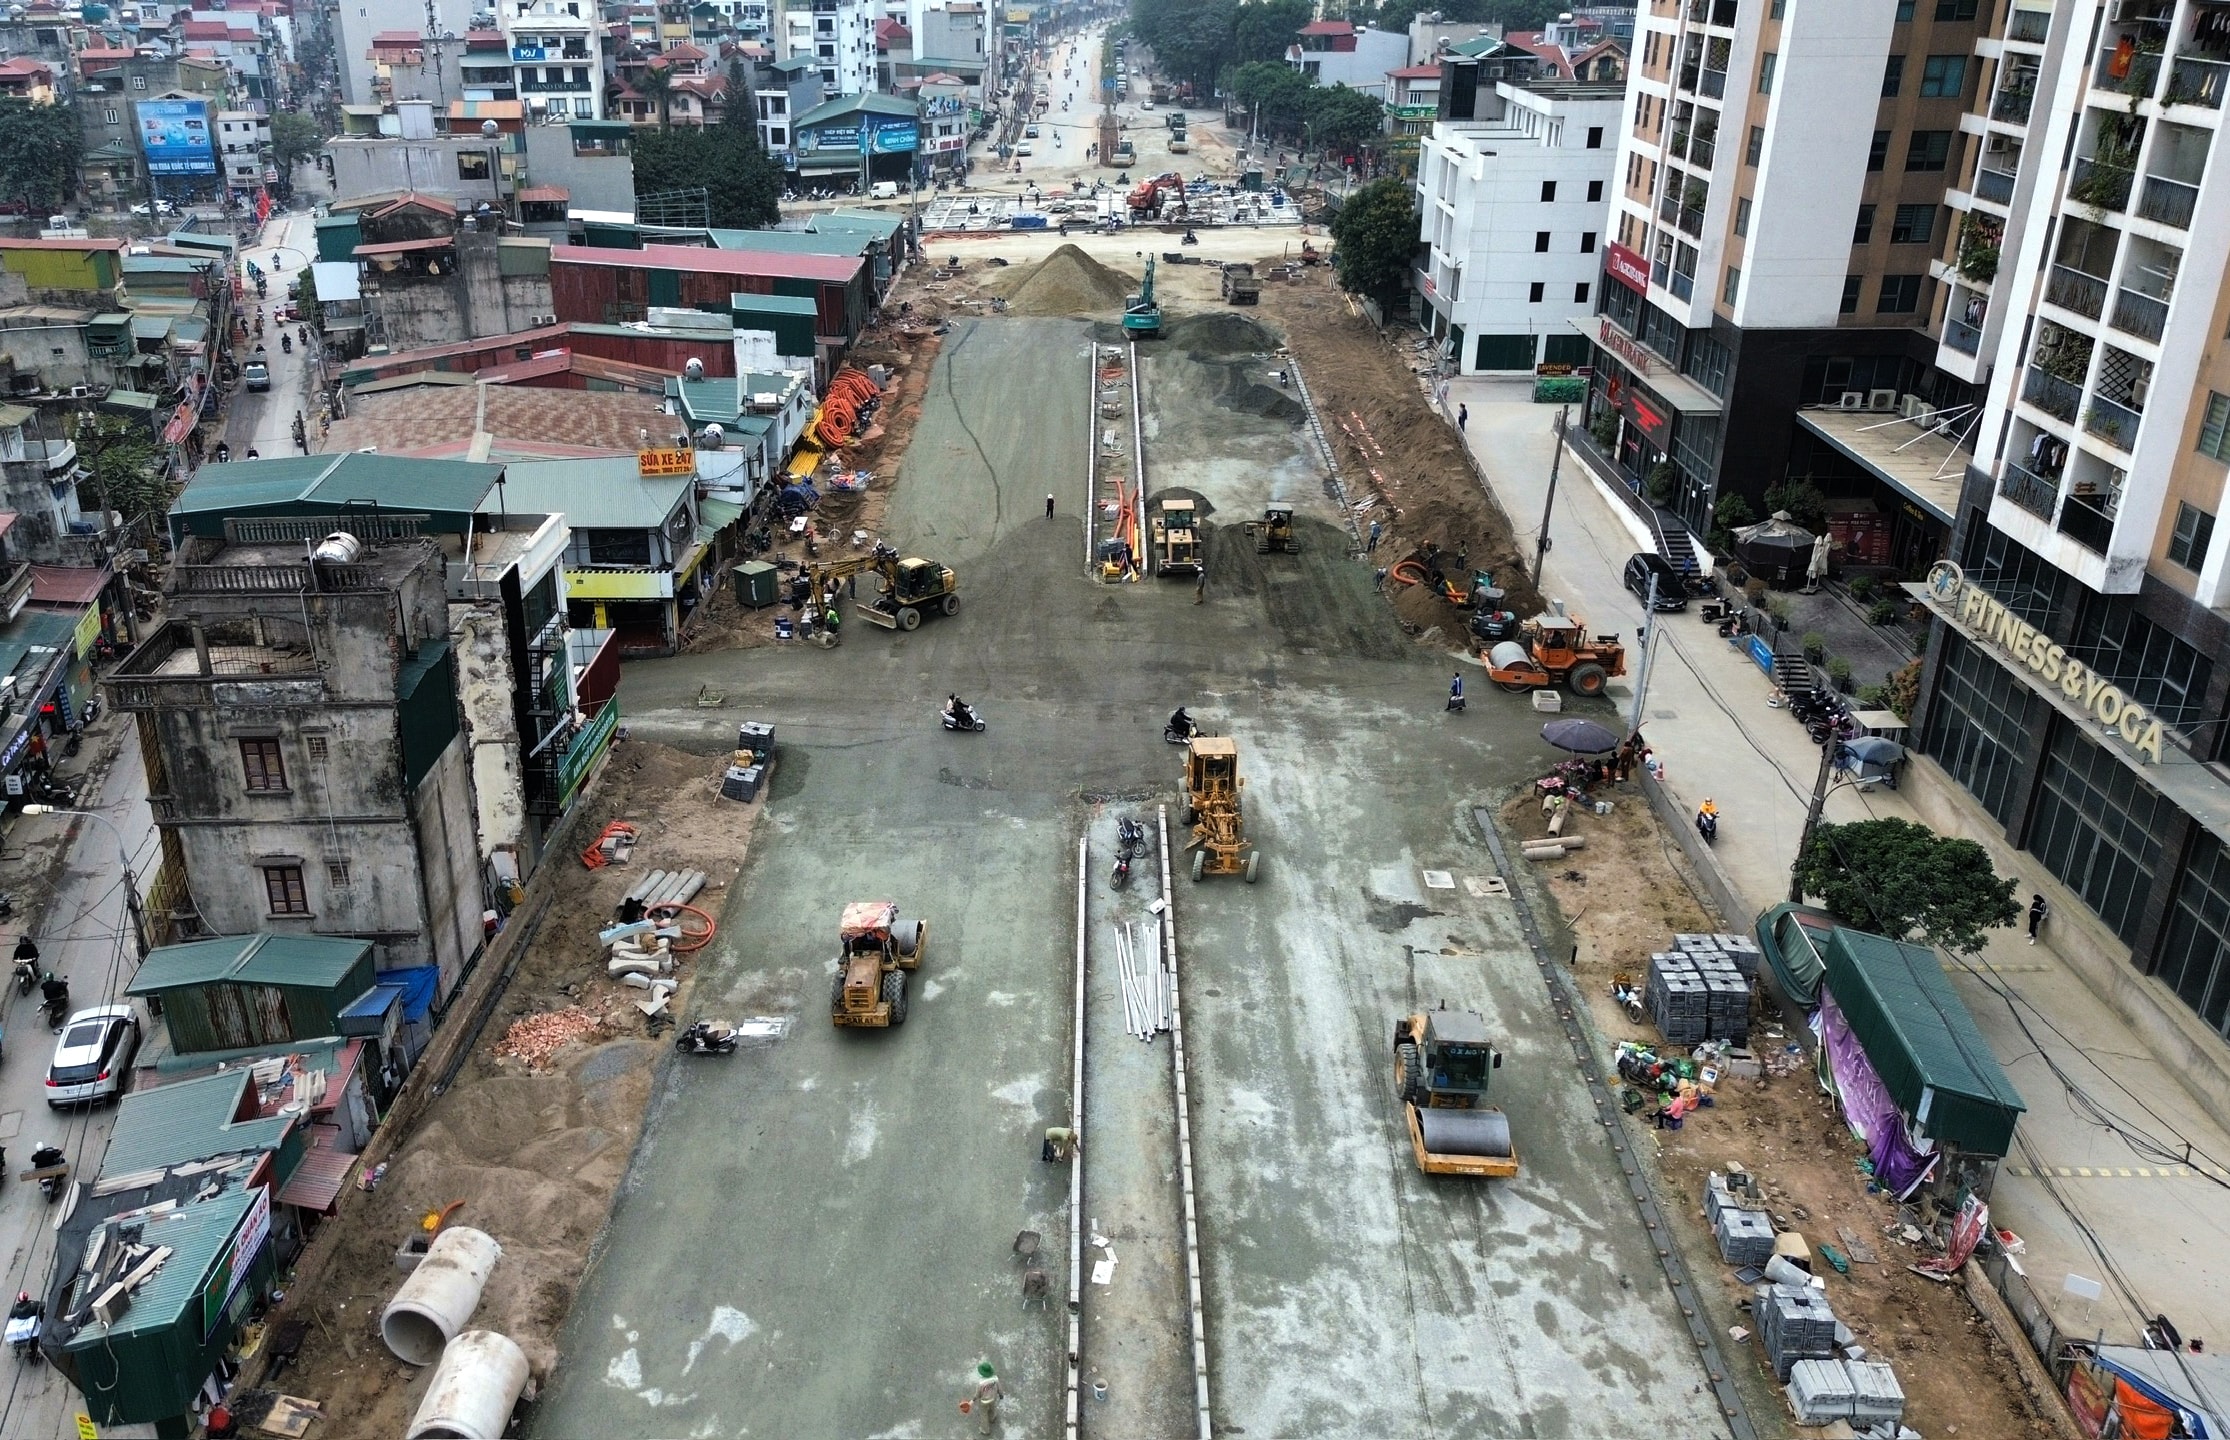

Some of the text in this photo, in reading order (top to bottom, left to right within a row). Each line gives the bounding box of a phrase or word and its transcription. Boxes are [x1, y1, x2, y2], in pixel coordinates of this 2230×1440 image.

[1620, 261, 1647, 288] AGRIBANK
[641, 451, 691, 466] SỬA XE 247
[1963, 586, 2066, 682] FITNESS
[2083, 669, 2163, 765] YOGA
